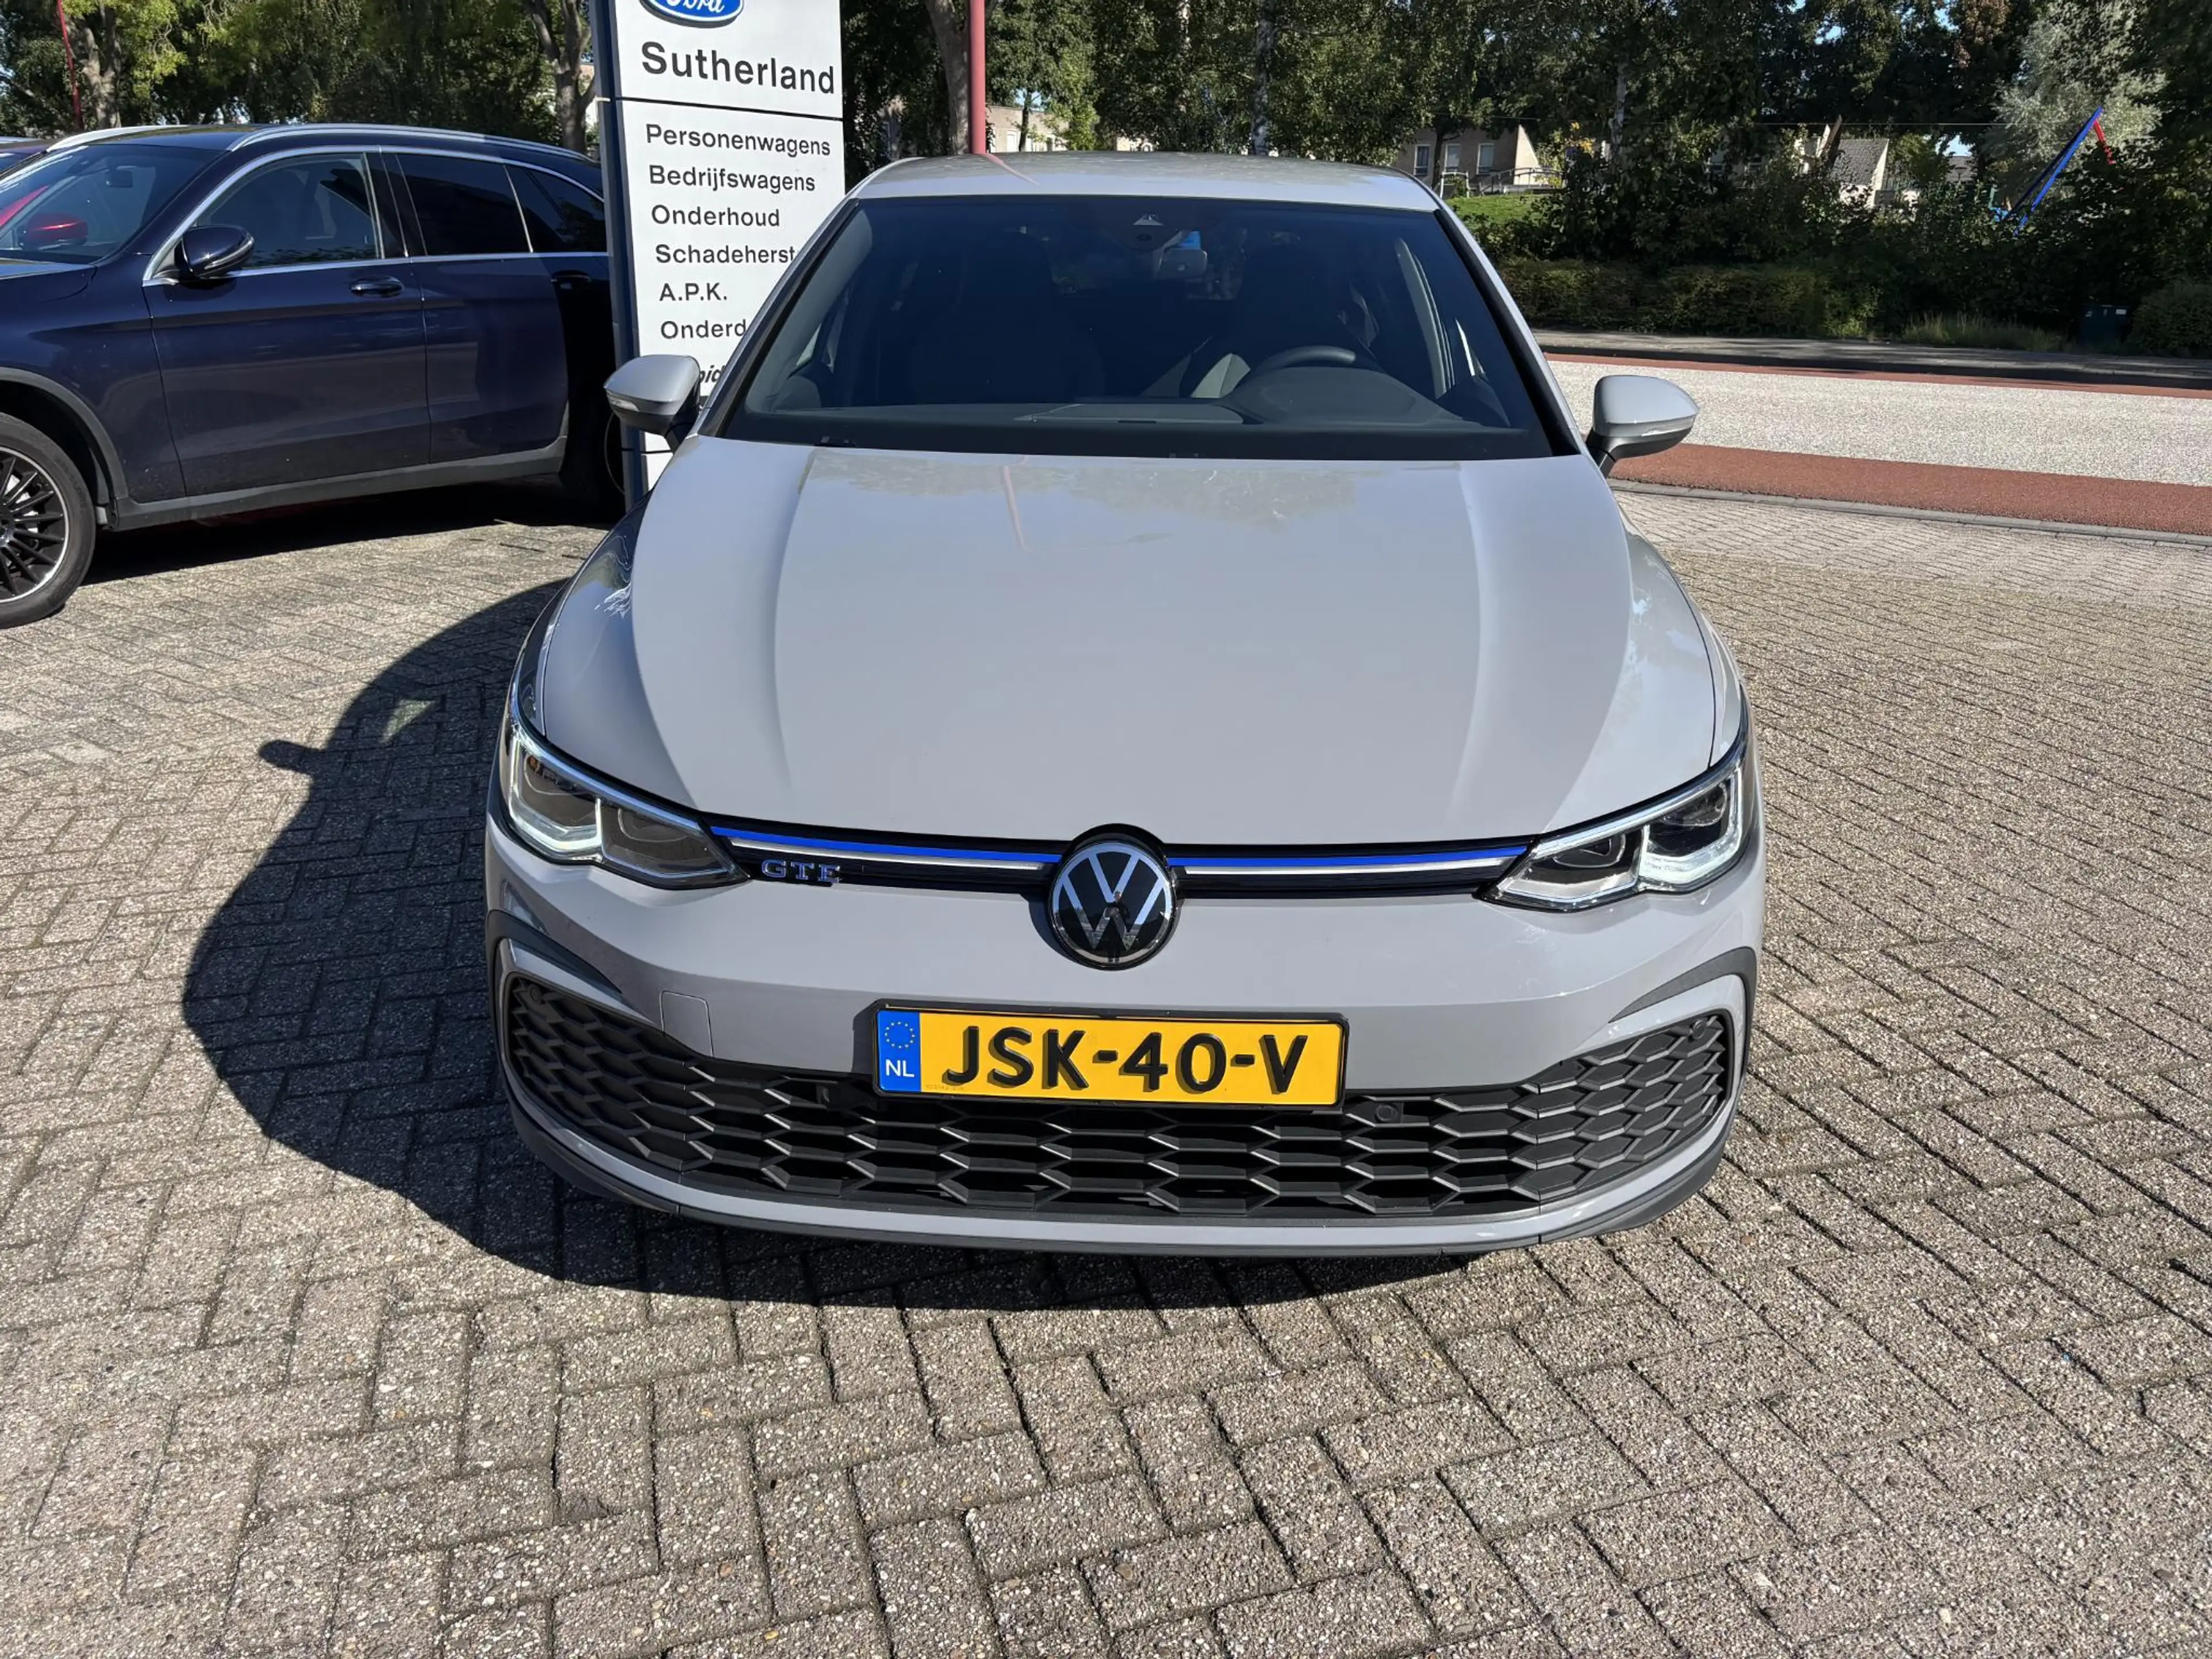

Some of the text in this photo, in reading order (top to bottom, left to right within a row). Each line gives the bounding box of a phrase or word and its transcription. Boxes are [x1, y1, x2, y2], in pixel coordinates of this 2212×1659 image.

[641, 41, 834, 94] Sutherland
[646, 123, 831, 158] Personenwagens
[649, 165, 815, 194] Bedrijfswagens
[652, 204, 780, 227] Onderhoud
[656, 244, 796, 264] Schadeherst
[659, 282, 728, 301] A.P.K.
[661, 319, 747, 339] Onderd
[762, 859, 840, 882] GTE
[885, 1059, 914, 1078] NL
[941, 1026, 1308, 1095] JSK-40-V
